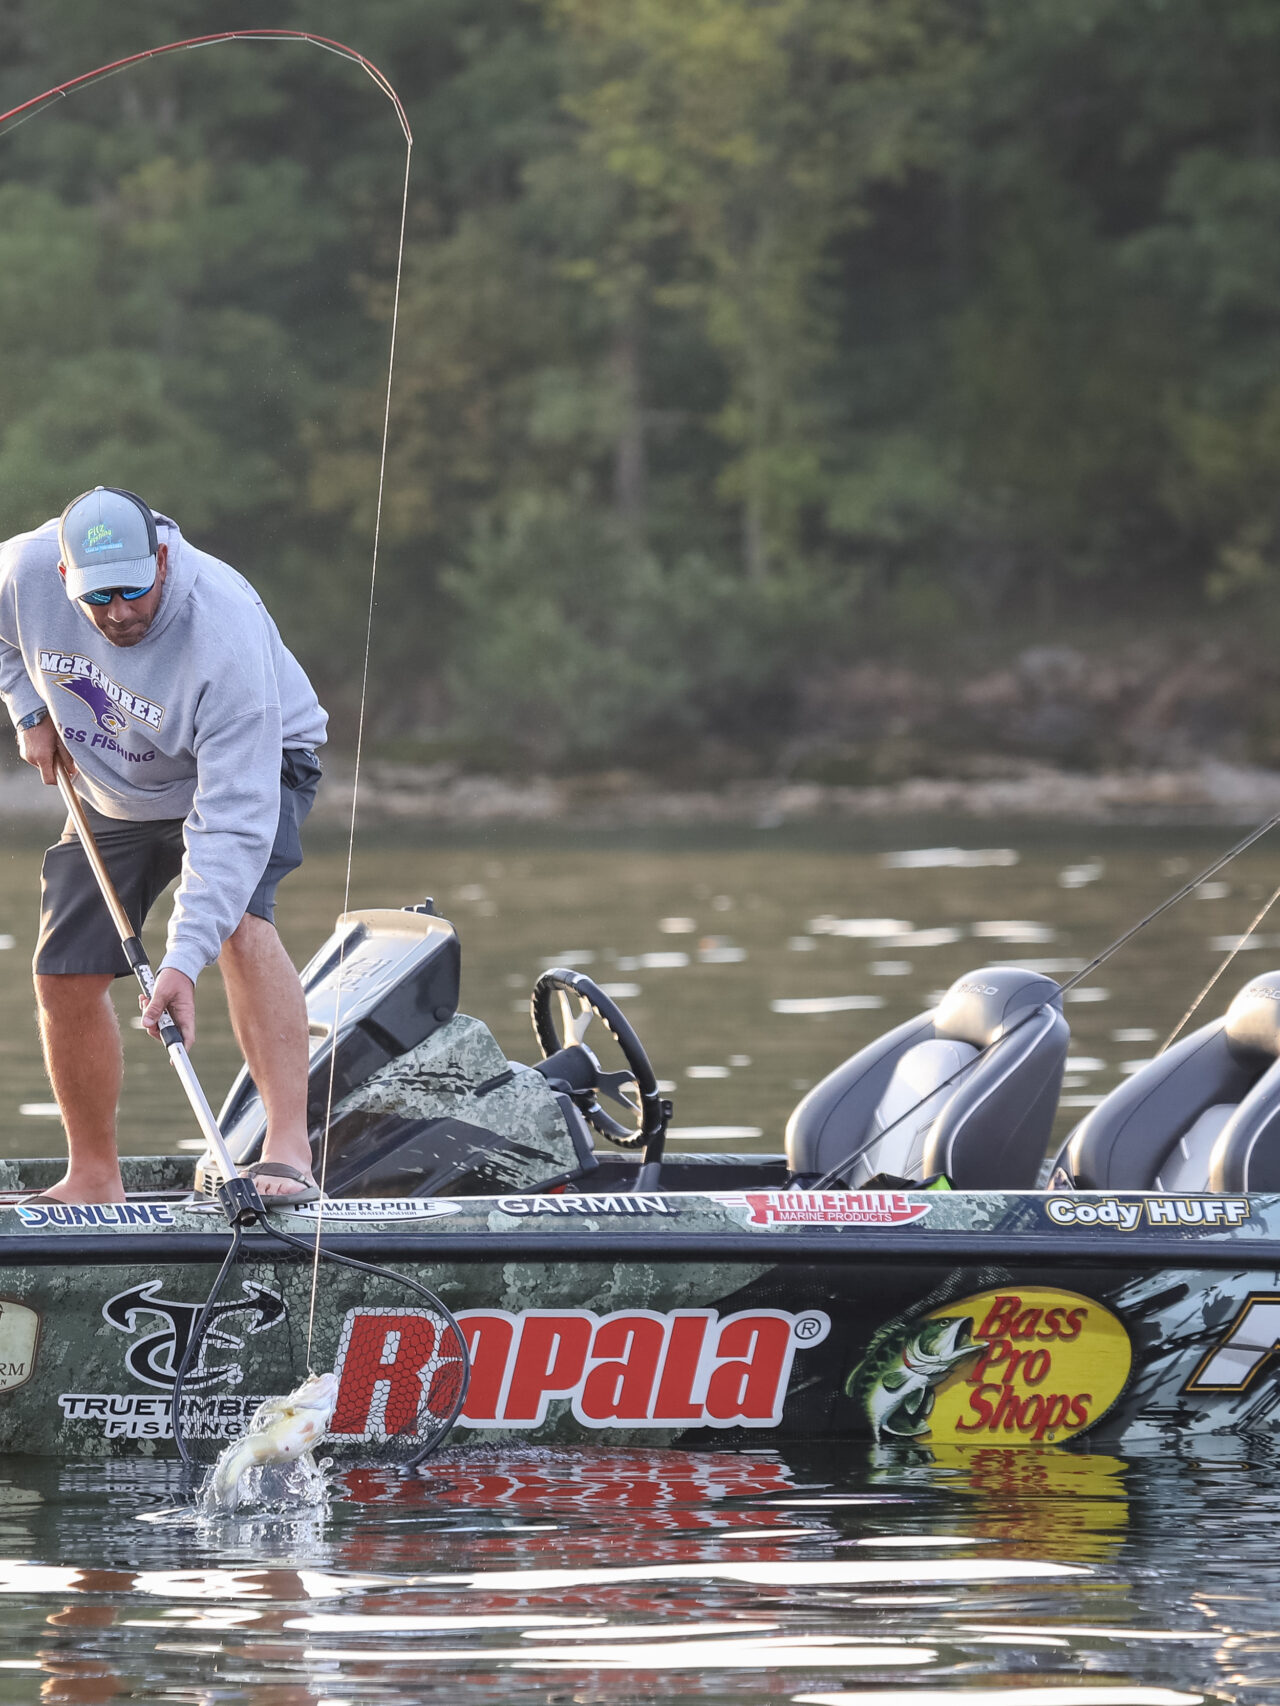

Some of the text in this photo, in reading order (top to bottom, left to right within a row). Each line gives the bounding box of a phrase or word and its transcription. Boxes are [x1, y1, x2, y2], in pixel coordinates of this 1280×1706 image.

[90, 733, 156, 764] FISHING
[19, 1204, 175, 1226] SUNLINE
[294, 1202, 436, 1212] POWER-POLE
[498, 1197, 668, 1213] GARMIN
[1048, 1199, 1248, 1230] Cody HUFF
[780, 1211, 893, 1222] MARINE PRODUCTS
[973, 1295, 1089, 1341] Bass
[966, 1339, 1052, 1385] Pro
[62, 1397, 263, 1417] TRUETIMBE
[954, 1382, 1093, 1441] Shops
[108, 1421, 242, 1436] FISHING
